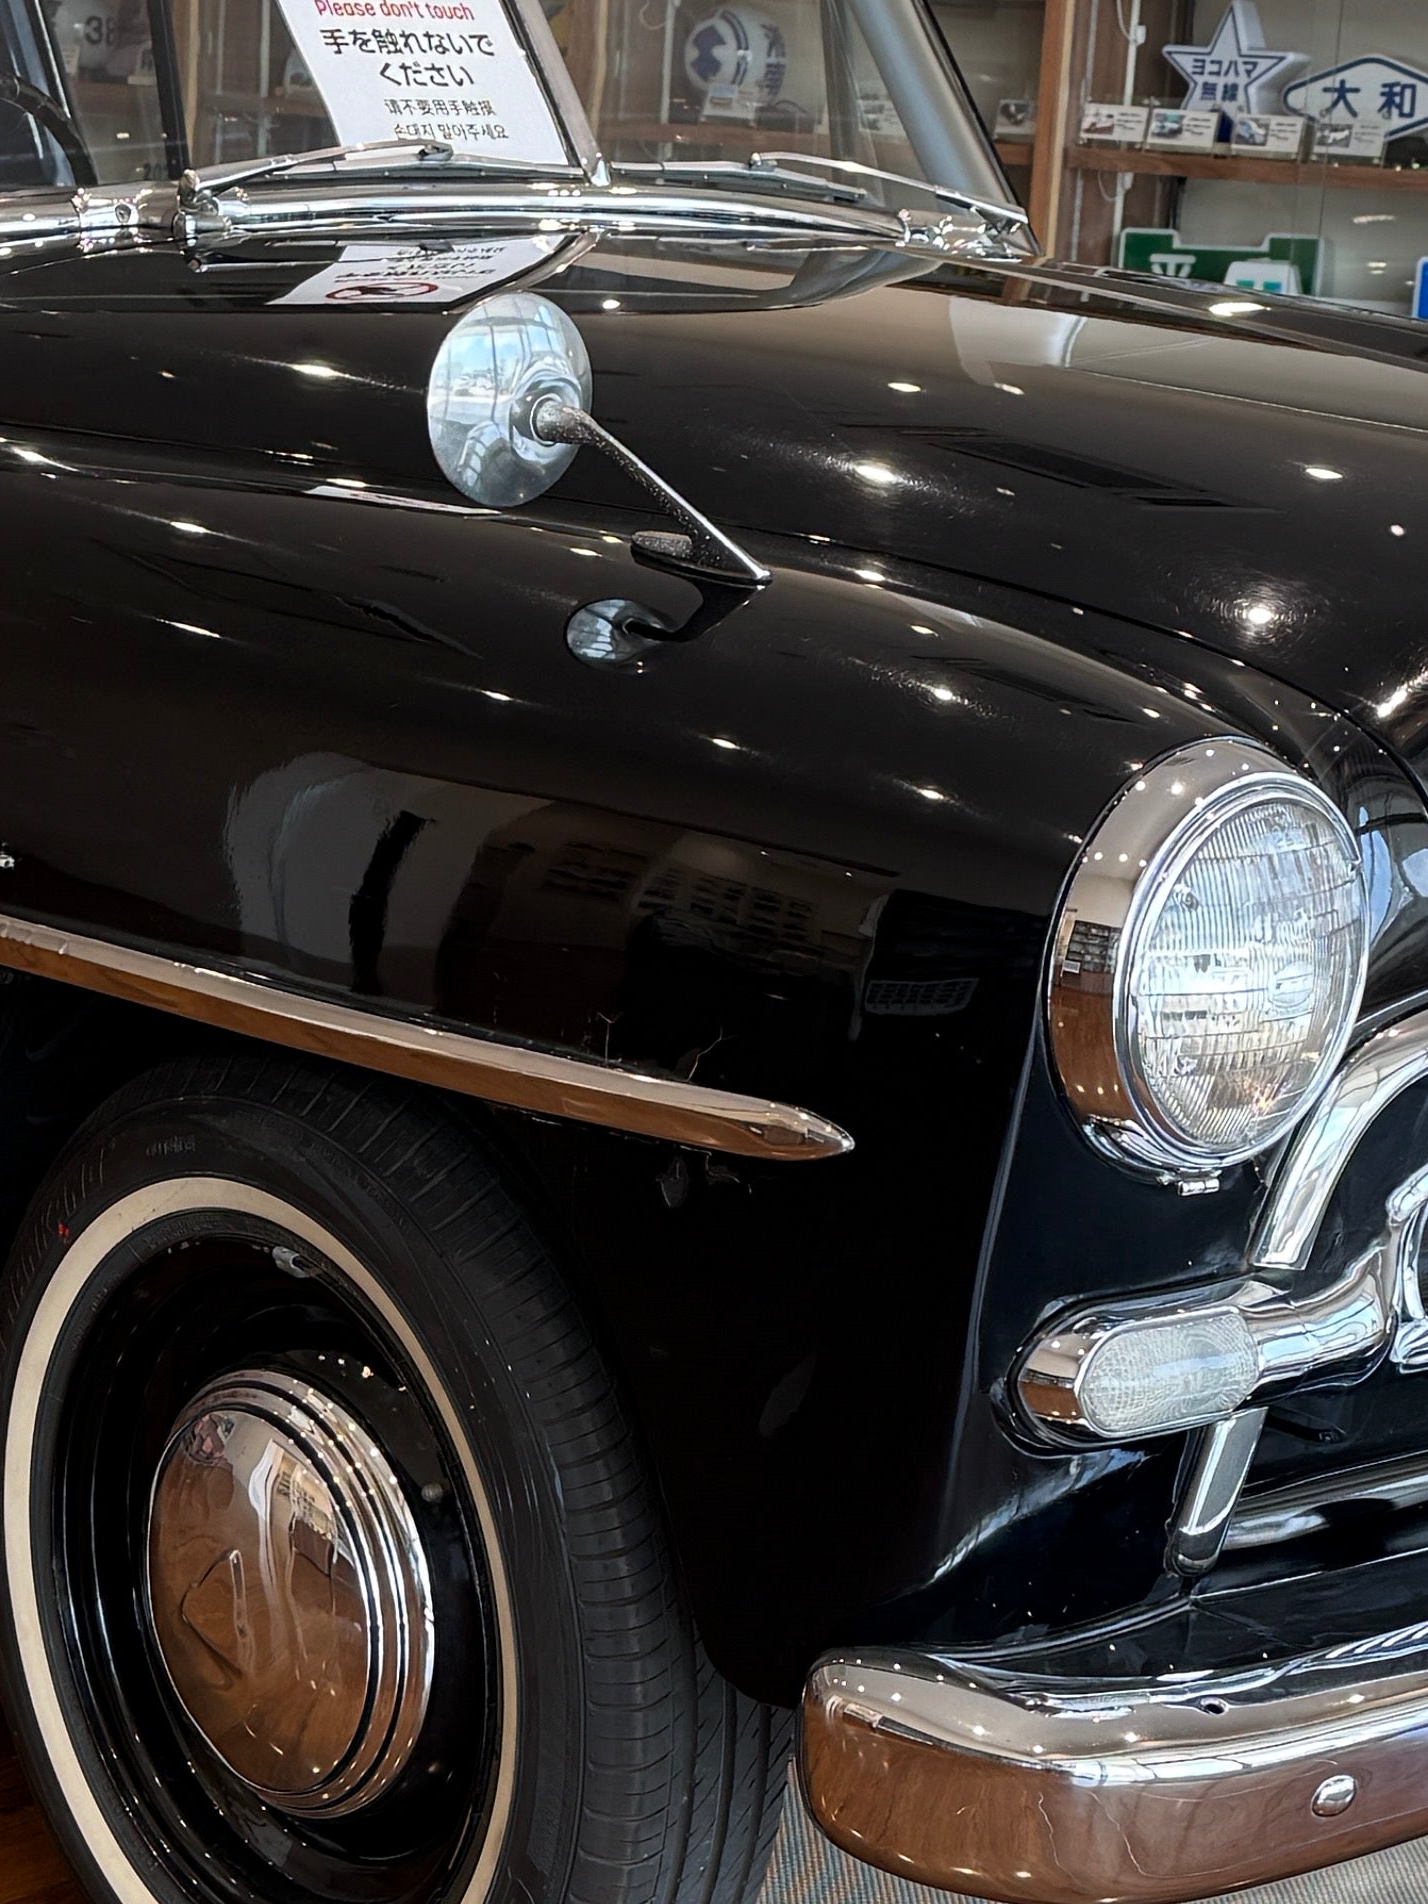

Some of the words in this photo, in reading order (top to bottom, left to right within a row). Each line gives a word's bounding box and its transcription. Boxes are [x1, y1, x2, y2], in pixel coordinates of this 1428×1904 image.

[380, 0, 424, 19] don't
[426, 1, 475, 21] touch
[321, 27, 494, 56] 手を触れないで
[379, 61, 475, 87] ください
[1191, 57, 1259, 78] ヨコハマ
[1198, 80, 1240, 103] 無線
[1319, 78, 1418, 119] 大和
